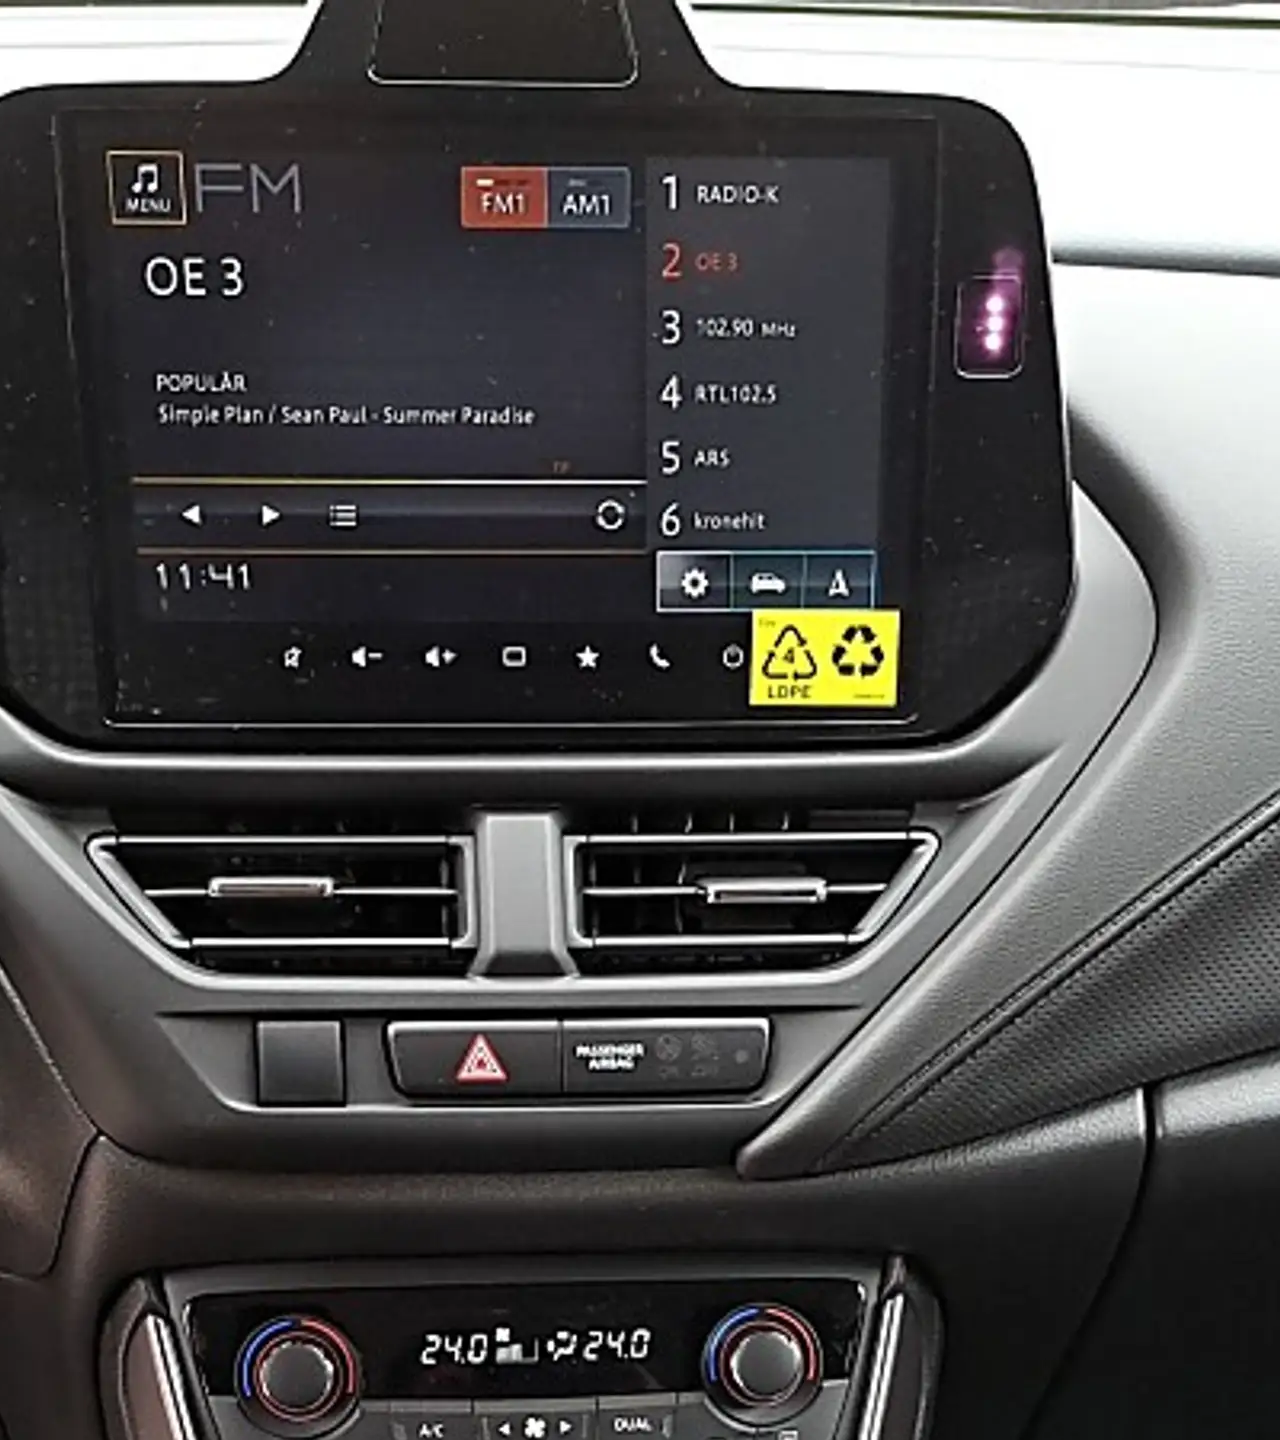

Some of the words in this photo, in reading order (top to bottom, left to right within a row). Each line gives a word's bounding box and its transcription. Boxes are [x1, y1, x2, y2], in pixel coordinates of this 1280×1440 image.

[195, 163, 301, 213] FM
[481, 192, 524, 215] FM1
[662, 175, 677, 210] 1
[697, 185, 779, 203] RADIO-K
[125, 199, 171, 213] MENU
[563, 194, 610, 216] AM1
[146, 257, 206, 295] OE
[221, 257, 244, 295] 3
[662, 243, 682, 277] 2
[662, 310, 681, 344] 3
[697, 317, 754, 338] 102.90
[660, 375, 682, 410] 4
[694, 384, 777, 404] RTL102.5
[158, 403, 219, 427] Simple
[224, 403, 264, 424] Plan
[281, 405, 324, 424] Sean
[330, 404, 368, 424] Paul
[383, 405, 456, 424] Summer
[461, 405, 535, 424] Paradise
[662, 441, 680, 475] 5
[661, 502, 680, 536] 6
[694, 512, 766, 530] kronehit
[156, 563, 251, 590] 11:41
[783, 647, 795, 664] 4
[767, 685, 812, 699] LDPE
[421, 1334, 489, 1366] 24.0
[582, 1328, 652, 1361] 24.0
[418, 1423, 445, 1439] A/C
[613, 1417, 652, 1433] DUAL
